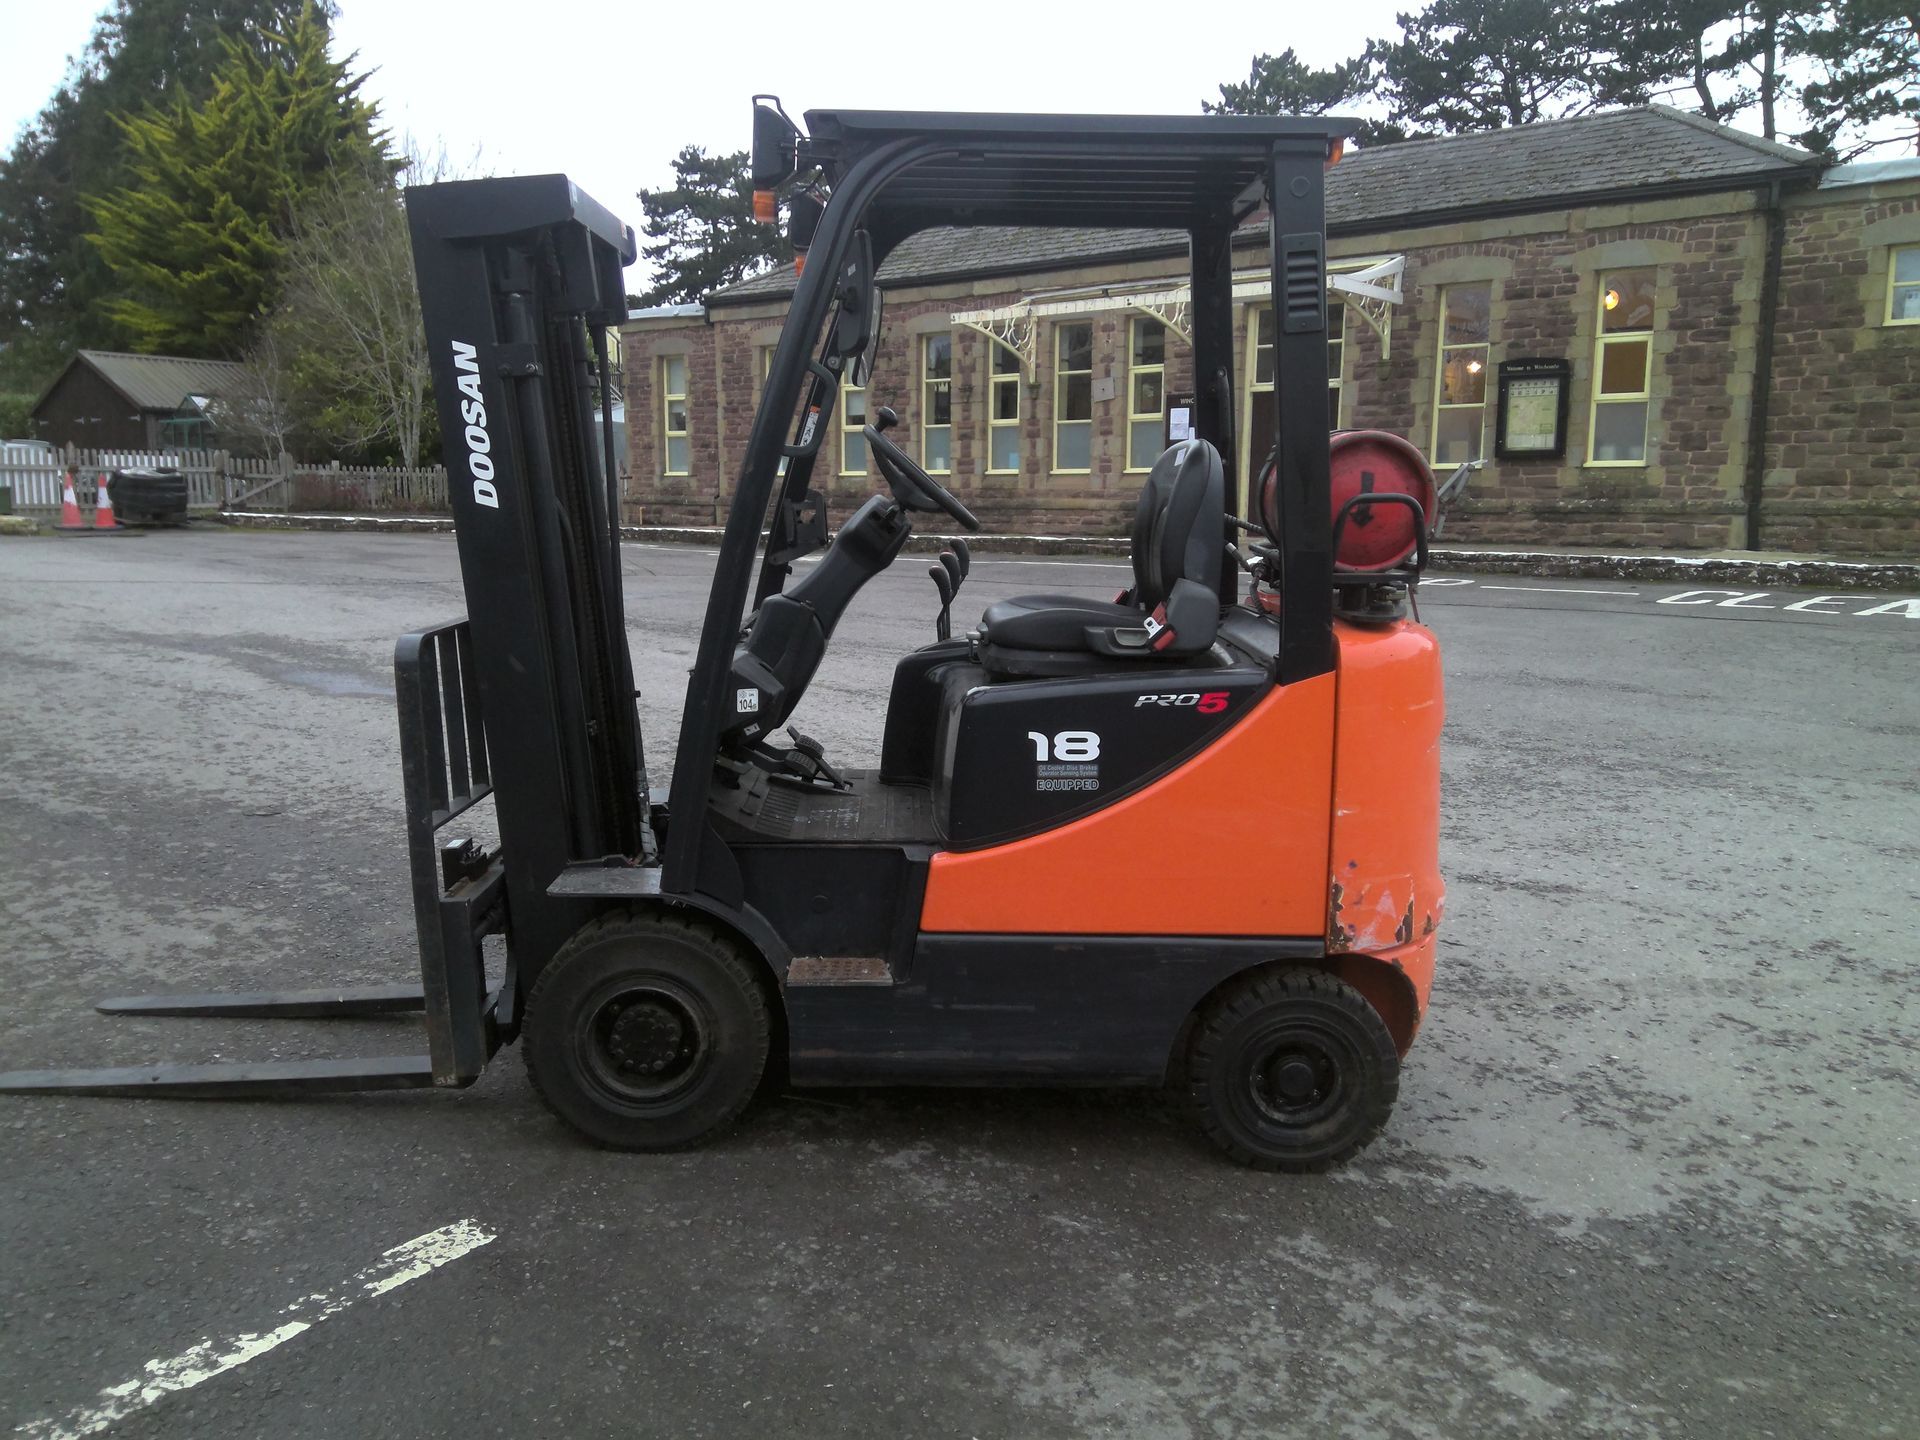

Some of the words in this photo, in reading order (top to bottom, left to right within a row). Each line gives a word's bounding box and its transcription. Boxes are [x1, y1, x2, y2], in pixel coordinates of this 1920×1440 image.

[452, 340, 499, 508] DOOSAN
[739, 699, 753, 710] 104
[1028, 731, 1101, 761] 18
[1036, 779, 1099, 791] EQUIPPED
